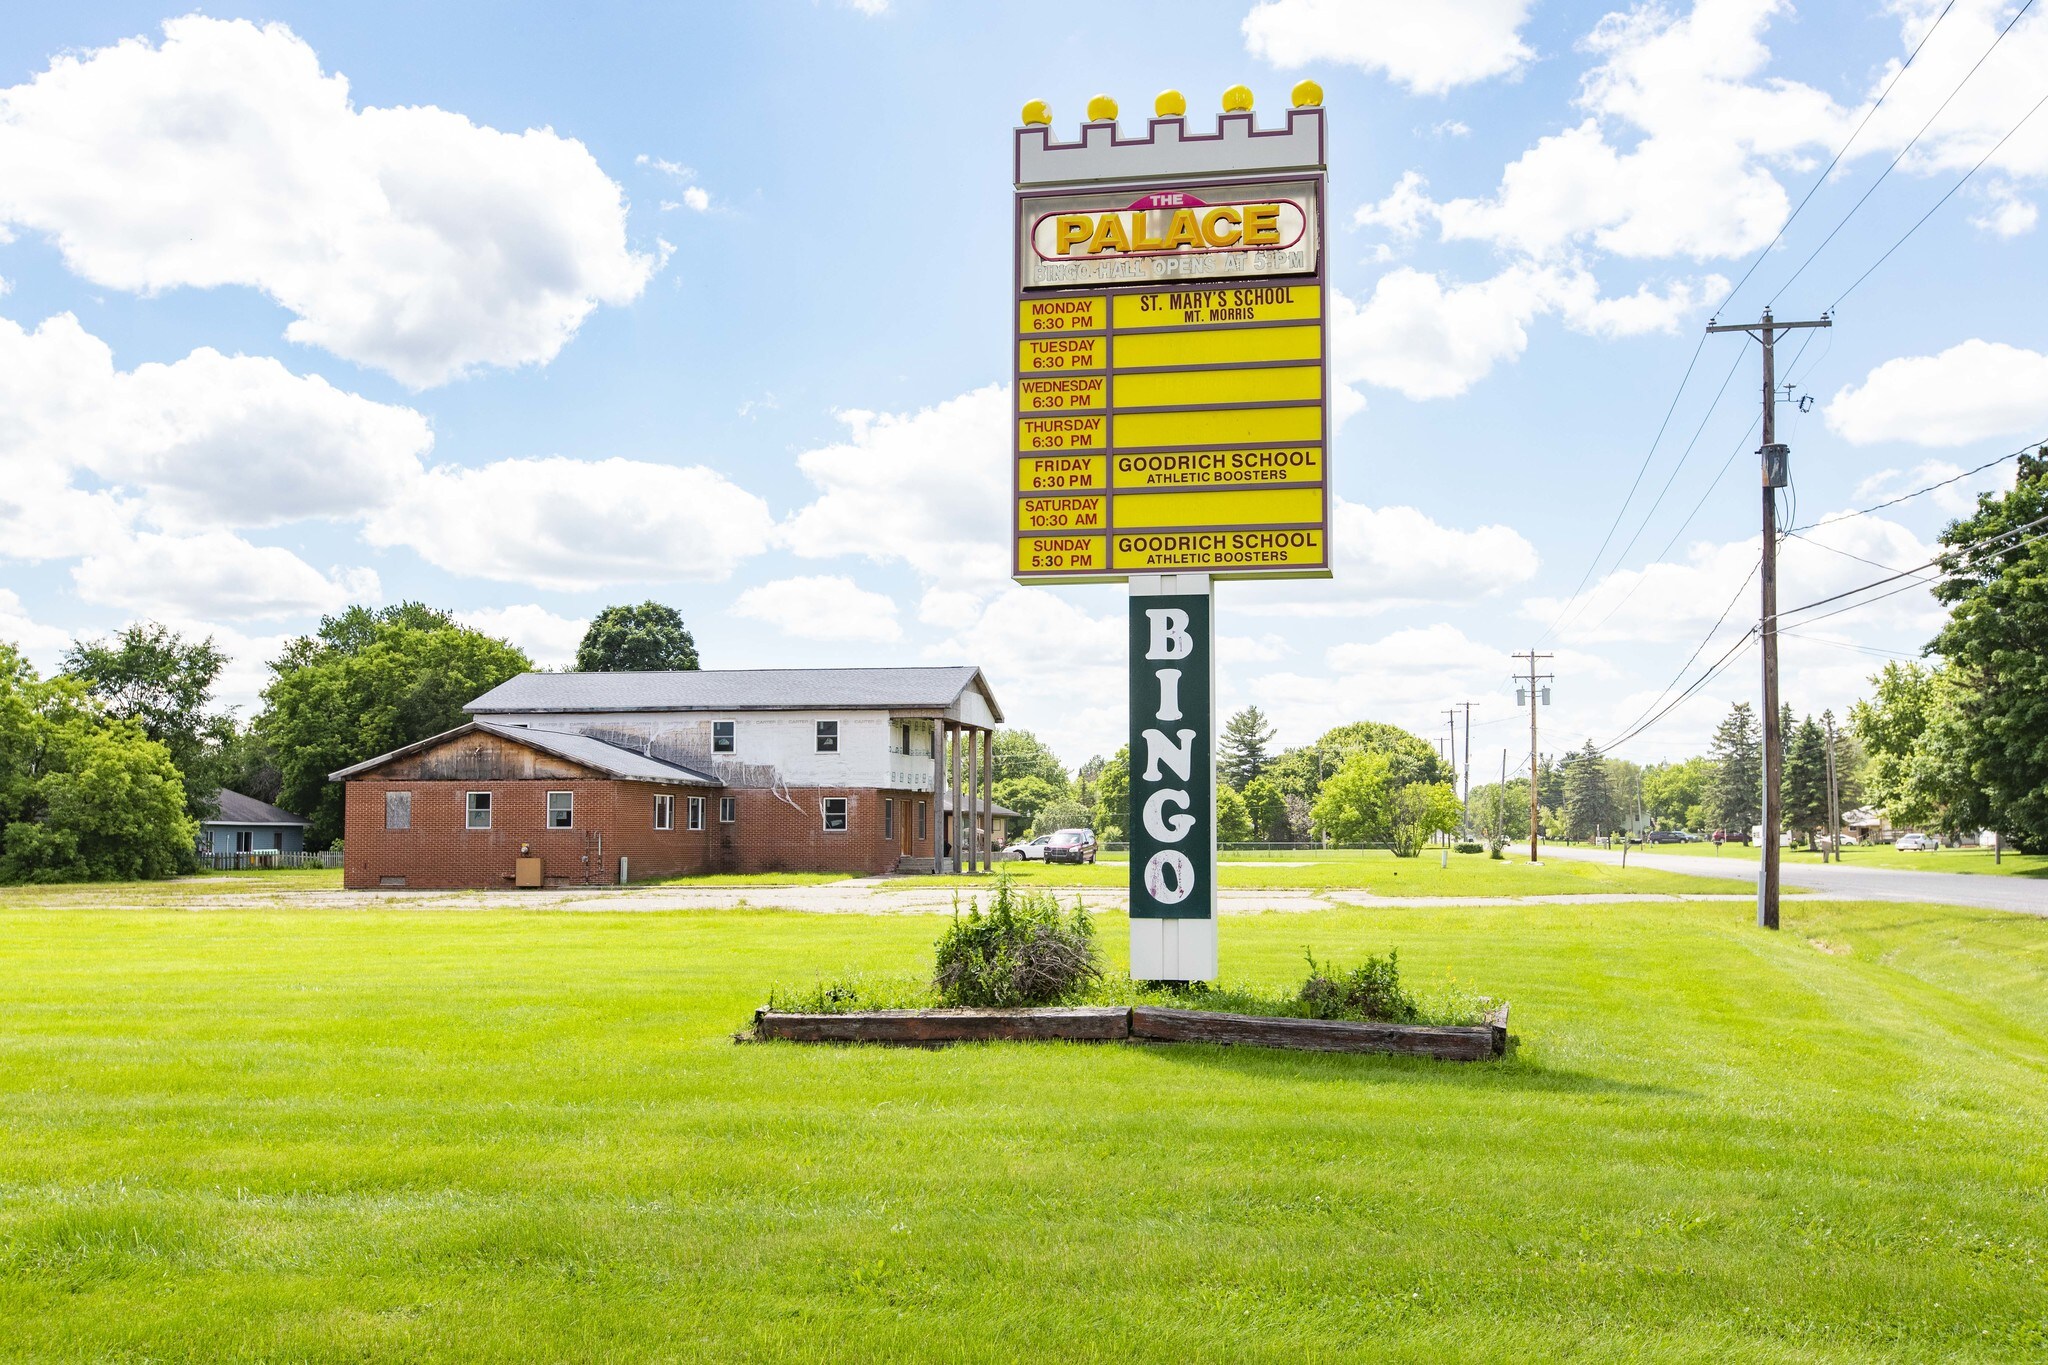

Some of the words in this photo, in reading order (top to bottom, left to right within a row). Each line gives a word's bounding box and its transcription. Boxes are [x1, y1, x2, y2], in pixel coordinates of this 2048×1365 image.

[1150, 194, 1184, 206] THE
[1056, 204, 1280, 255] PALACE
[1154, 255, 1216, 276] OPENS
[1225, 254, 1248, 271] AT
[1140, 295, 1163, 312] ST.
[1170, 291, 1227, 310] MARY'S
[1234, 287, 1294, 307] SCHOOL
[1032, 302, 1093, 315] MONDAY
[1184, 310, 1204, 323] MT.
[1209, 308, 1255, 321] MORRIS
[1033, 317, 1064, 330] 6:30
[1072, 316, 1093, 328] PM
[1030, 340, 1095, 354] TUESDAY
[1033, 357, 1064, 369] 6:30
[1072, 355, 1093, 367] PM
[1023, 379, 1103, 393] WEDNESDAY
[1033, 396, 1064, 408] 6:30
[1070, 395, 1091, 406] PM
[1024, 418, 1101, 433] THURSDAY
[1032, 436, 1064, 448] 6:30
[1071, 434, 1092, 446] PM
[1035, 459, 1092, 472] FRIDAY
[1118, 454, 1226, 472] GOODRICH
[1232, 452, 1317, 468] SCHOOL
[1033, 476, 1065, 488] 6:30
[1070, 475, 1092, 487] PM
[1147, 472, 1210, 484] ATHLETIC
[1214, 470, 1287, 482] BOOSTERS
[1025, 498, 1099, 512] SATURDAY
[1030, 514, 1068, 526] 10:30
[1075, 513, 1097, 525] AM
[1034, 539, 1092, 552] SUNDAY
[1119, 535, 1226, 553] GOODRICH
[1232, 533, 1317, 549] SCHOOL
[1032, 555, 1064, 567] 5:30
[1070, 554, 1092, 566] PM
[1147, 552, 1210, 564] ATHLETIC
[1214, 551, 1288, 562] BOOSTERS
[1142, 608, 1197, 905] BINGO
